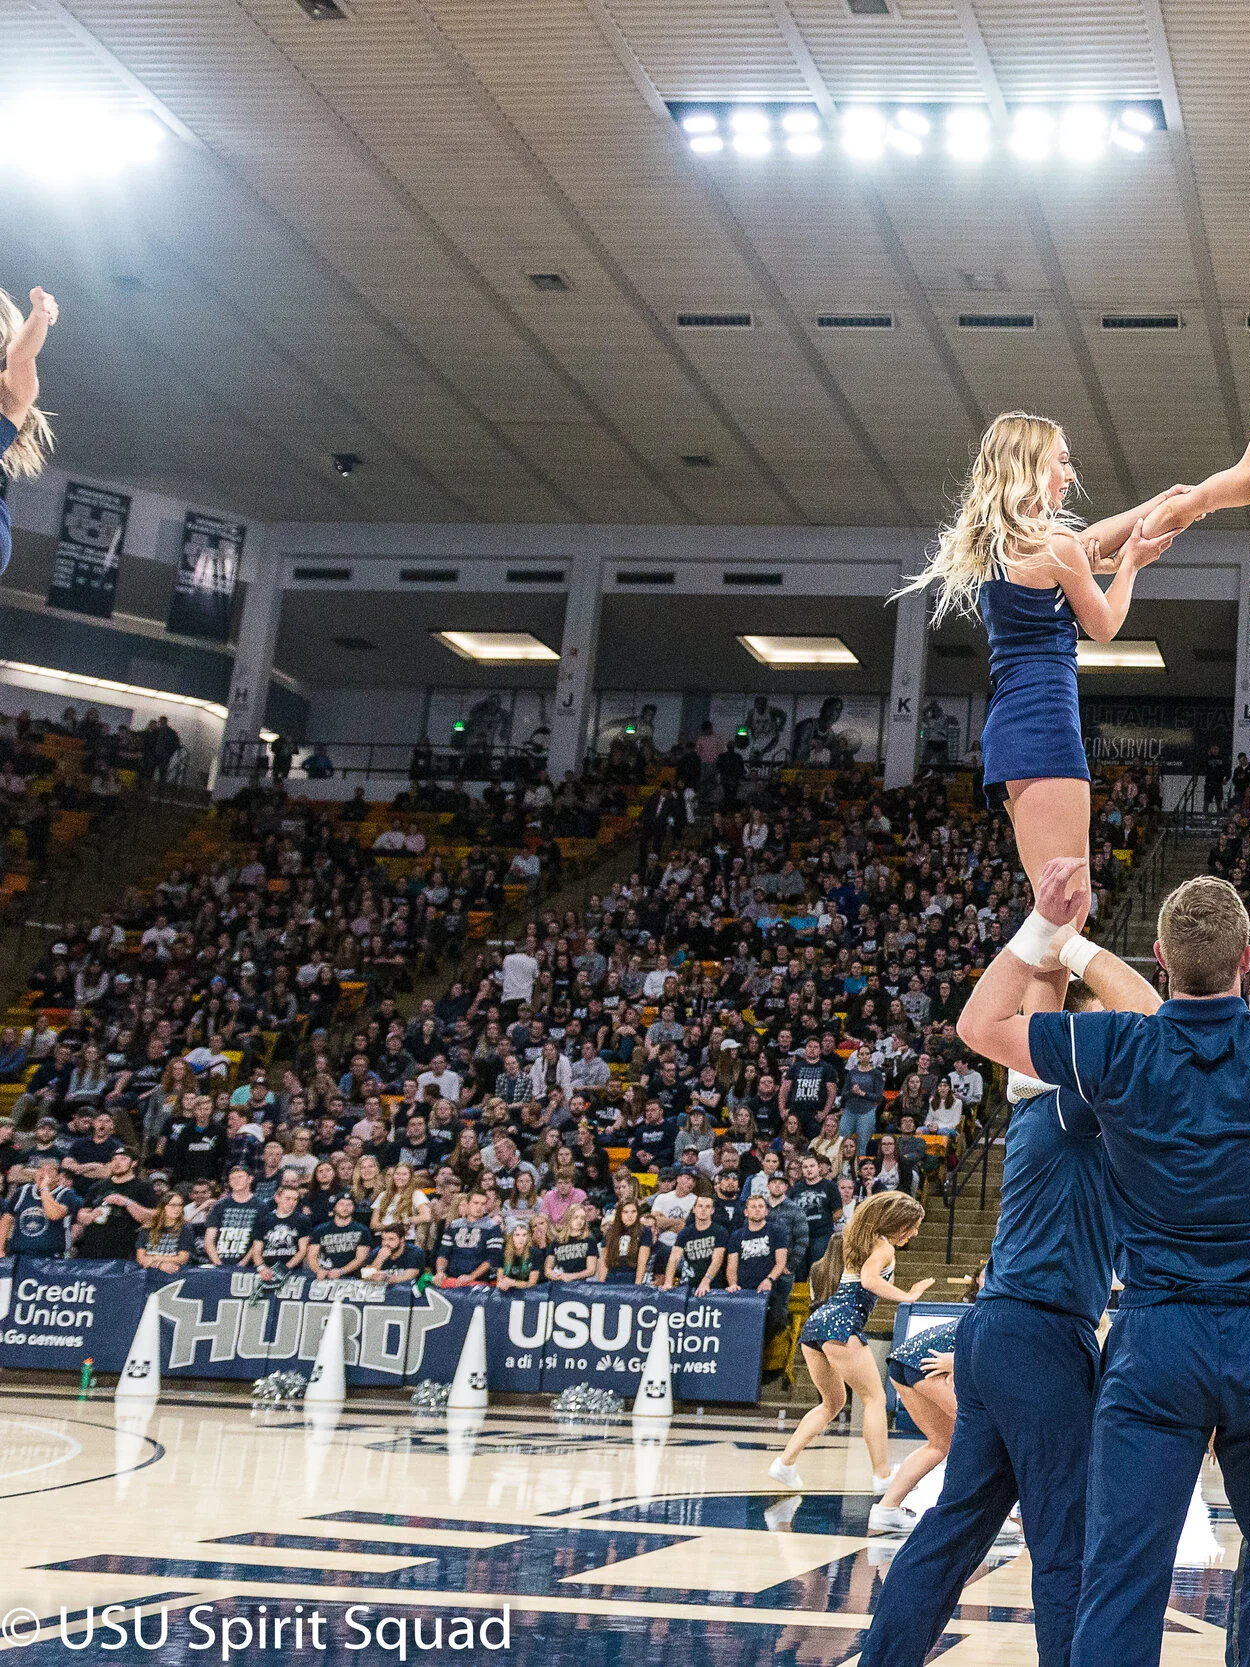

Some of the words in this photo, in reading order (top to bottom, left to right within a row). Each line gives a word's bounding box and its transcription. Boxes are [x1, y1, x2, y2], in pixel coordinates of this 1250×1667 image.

[897, 698, 911, 713] K
[796, 1078, 822, 1088] TRUE
[796, 1088, 820, 1098] BLUE
[219, 1227, 252, 1240] TRUE
[216, 1240, 248, 1253] BLUE
[17, 1278, 97, 1304] Credit
[14, 1303, 94, 1328] Union
[508, 1300, 633, 1351] USU
